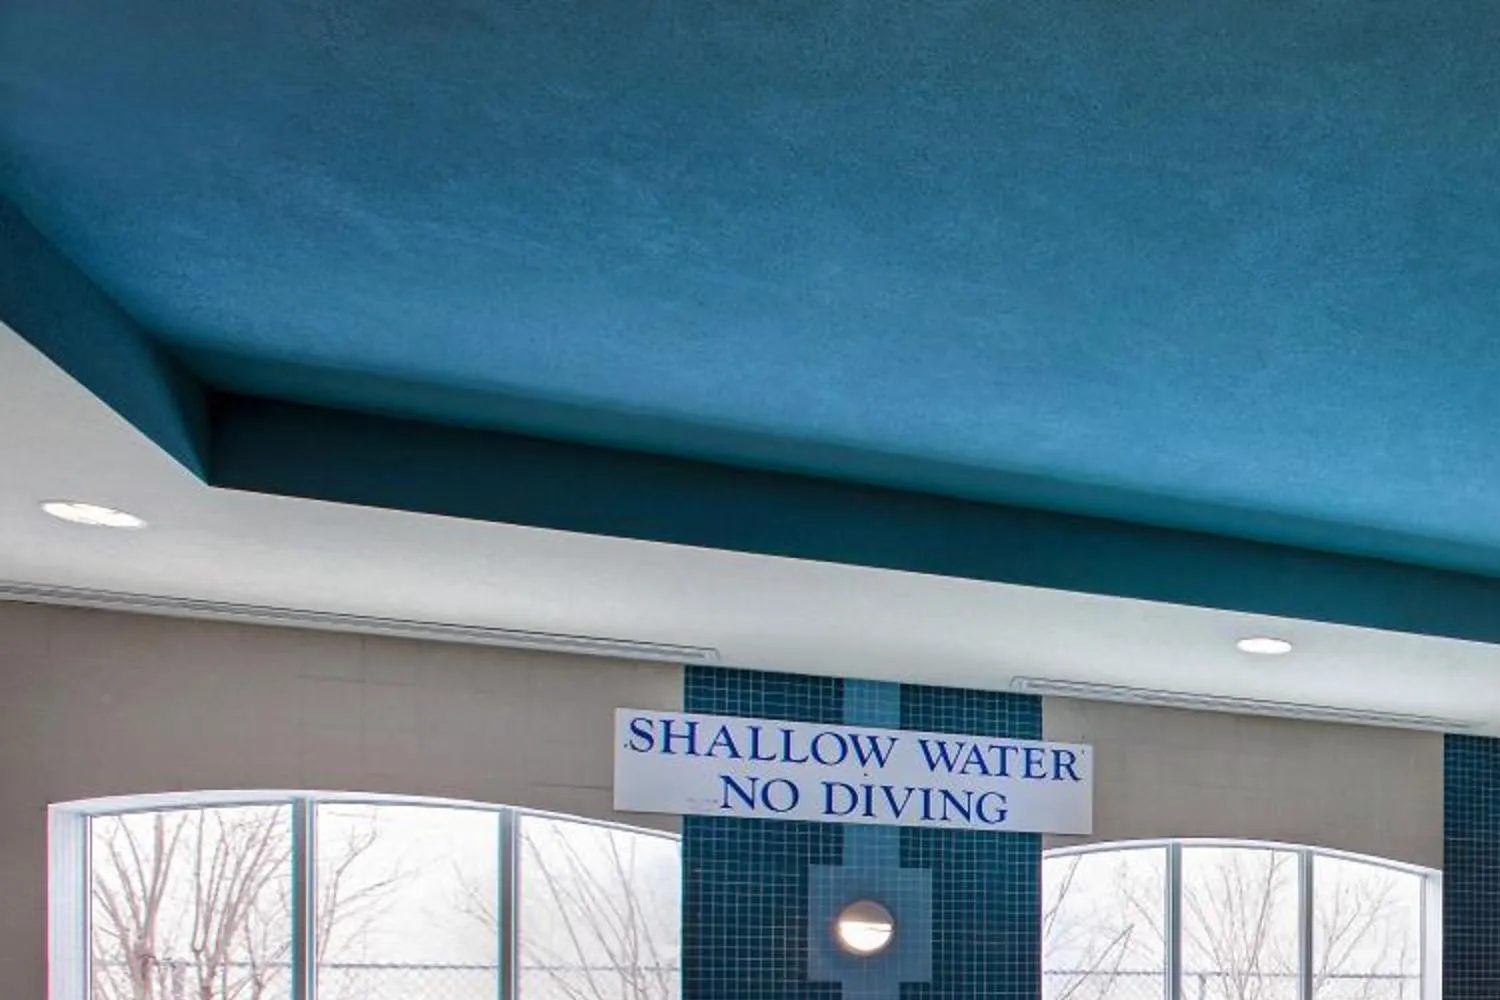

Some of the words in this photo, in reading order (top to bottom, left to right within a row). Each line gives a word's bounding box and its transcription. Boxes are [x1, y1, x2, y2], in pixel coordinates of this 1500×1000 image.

[628, 715, 898, 769] SHALLOW
[918, 738, 1083, 782] WATER
[719, 775, 801, 814] NO
[821, 780, 1010, 826] DIVING
